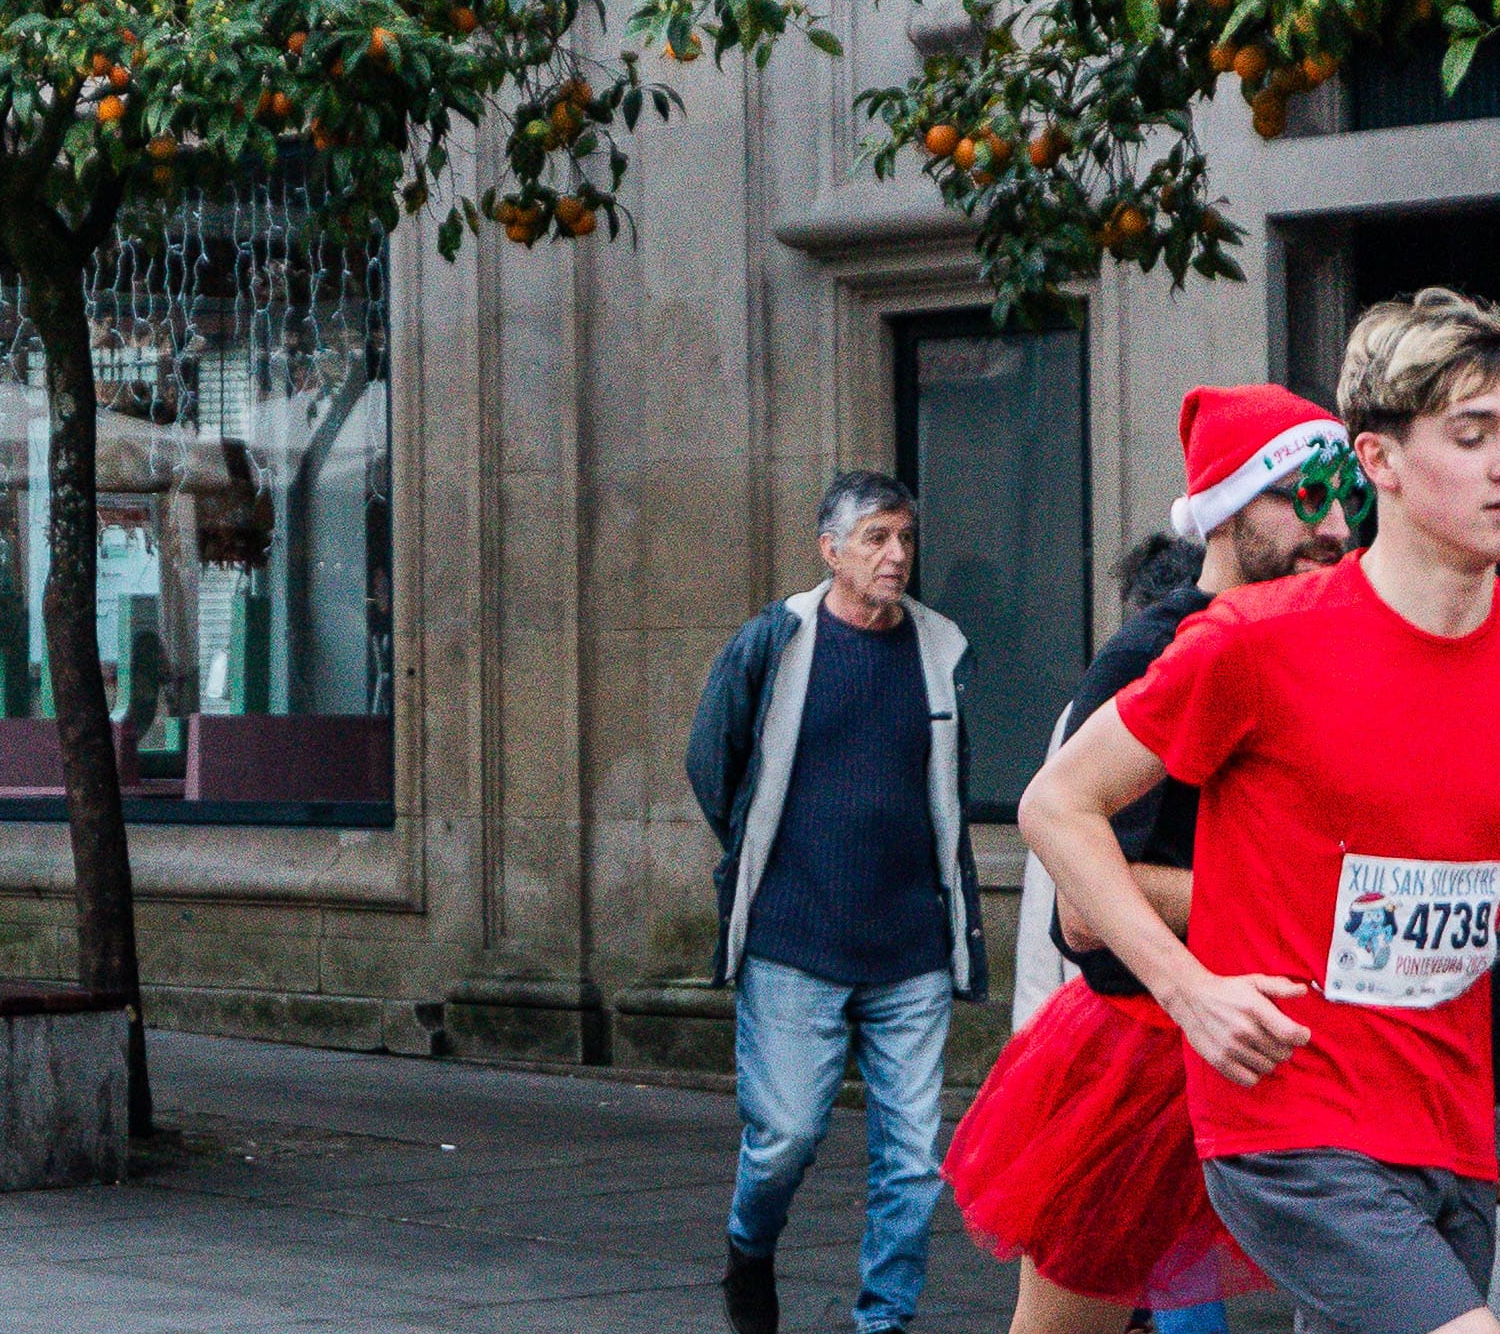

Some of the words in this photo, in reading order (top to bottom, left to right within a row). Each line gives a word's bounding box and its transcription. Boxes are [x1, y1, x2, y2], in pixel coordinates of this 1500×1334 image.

[1391, 867, 1426, 896] SAN
[1430, 867, 1498, 896] SILVESTRE
[1403, 901, 1491, 949] 4739
[1395, 954, 1462, 976] PONTEVEDRA
